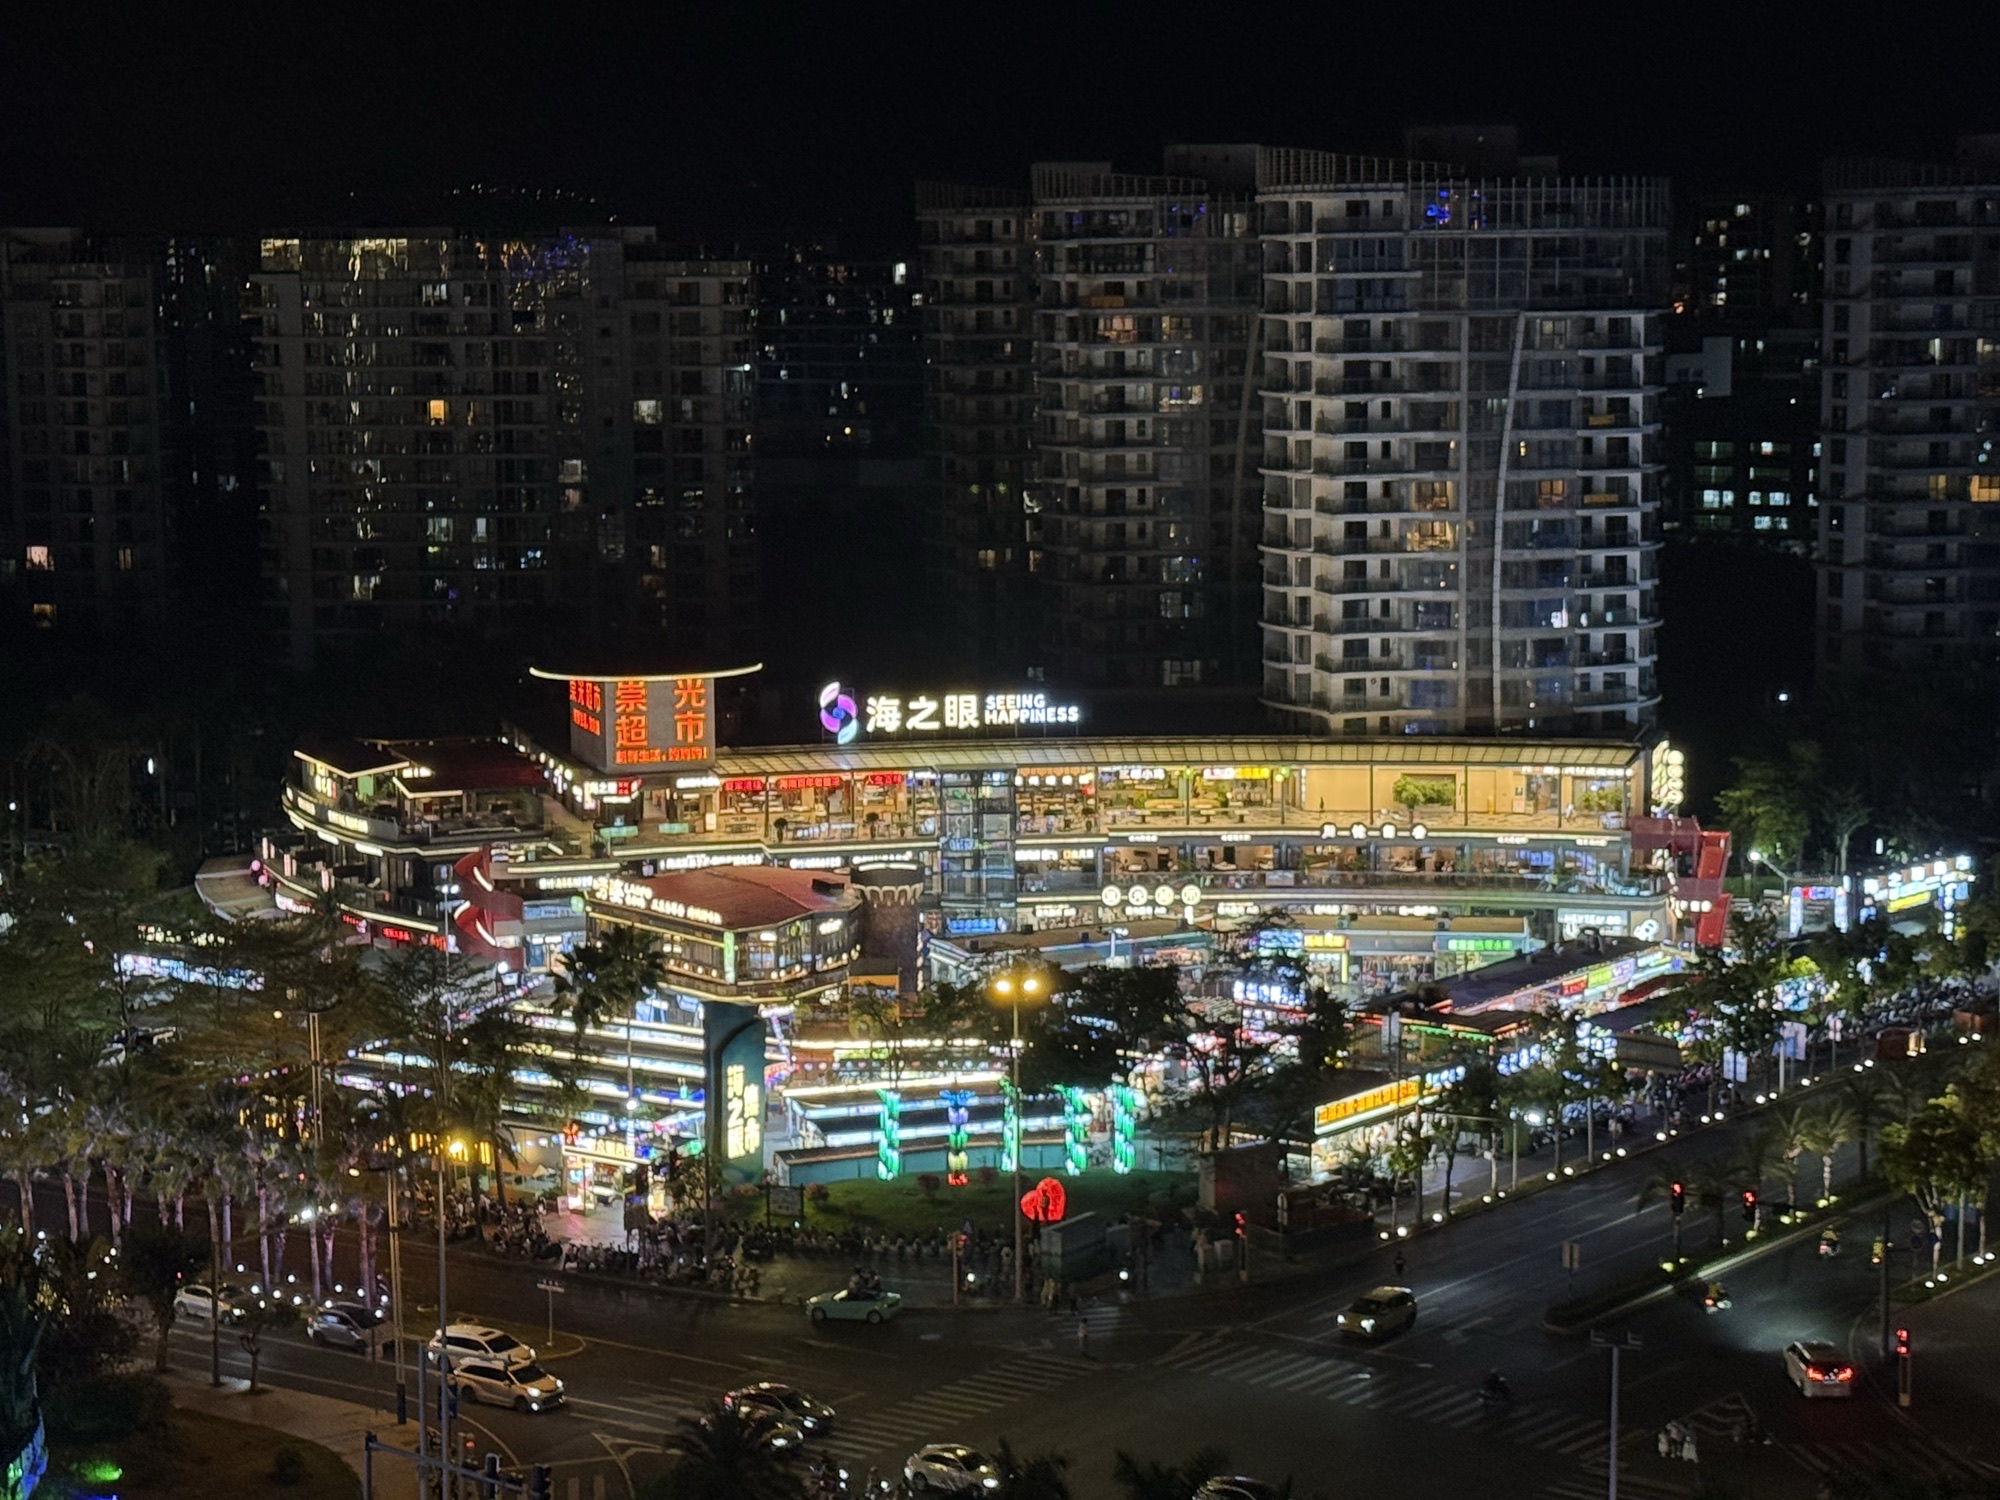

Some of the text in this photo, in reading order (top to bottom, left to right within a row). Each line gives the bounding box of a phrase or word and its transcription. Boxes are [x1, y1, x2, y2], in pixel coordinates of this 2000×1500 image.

[865, 694, 980, 733] 海之眼
[984, 706, 1079, 726] HAPPINESS
[985, 693, 1046, 710] SEEING
[615, 710, 707, 748] 超市
